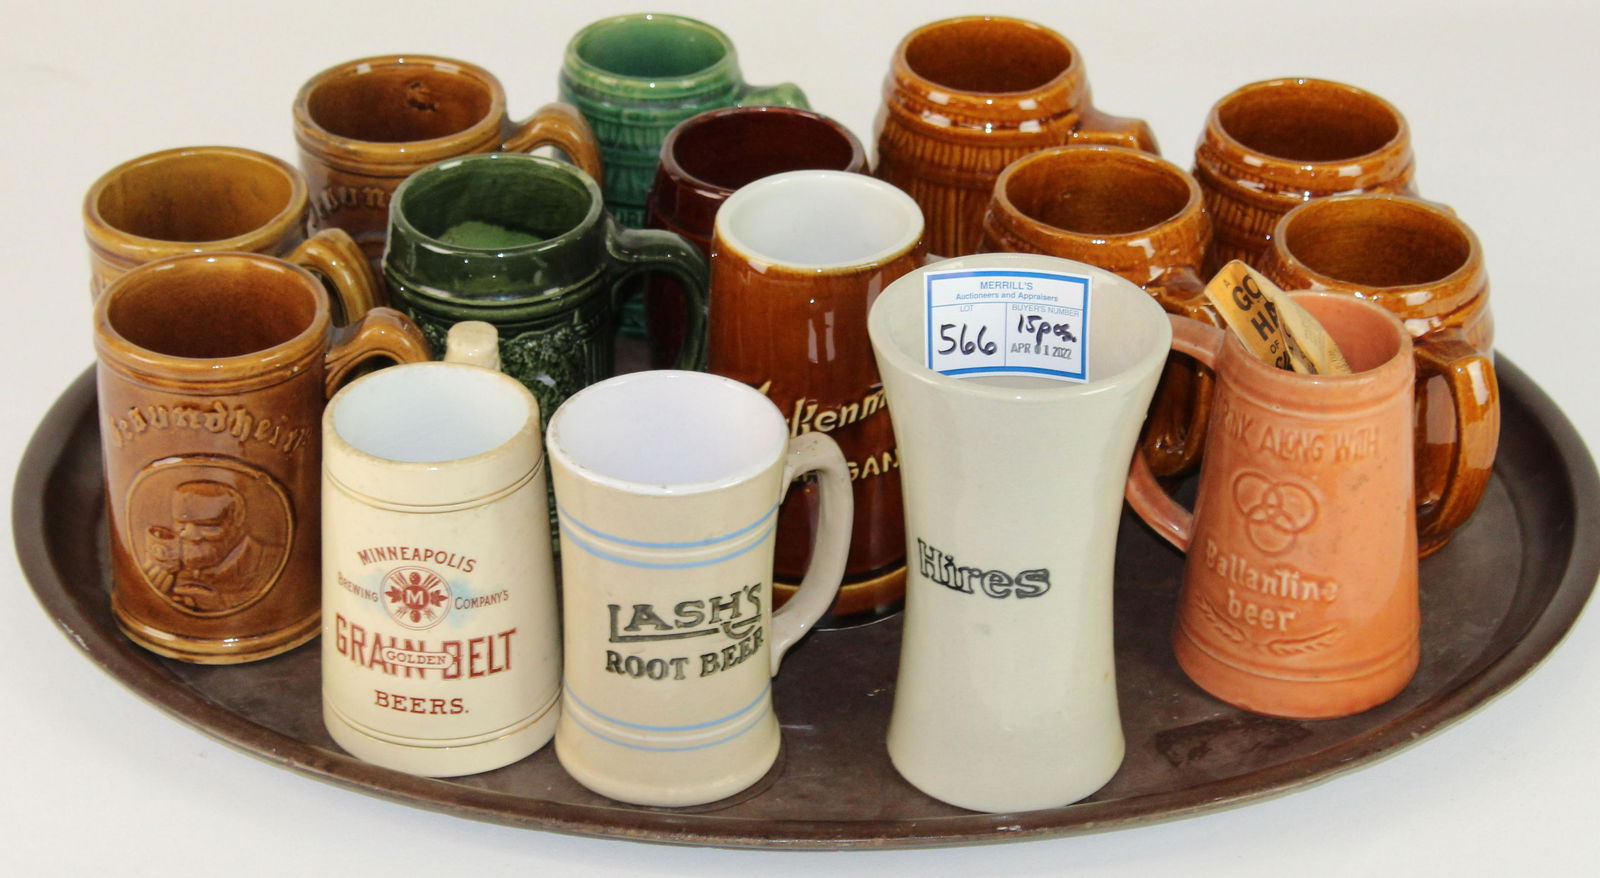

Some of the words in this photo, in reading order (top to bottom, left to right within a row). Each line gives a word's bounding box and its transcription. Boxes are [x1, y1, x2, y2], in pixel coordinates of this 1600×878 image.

[956, 292, 999, 301] Auctioneers
[1018, 292, 1059, 302] Appraisers
[980, 281, 1034, 290] MERRILL'S
[1012, 305, 1046, 314] BUYER'S
[1048, 307, 1080, 317] NUMBER
[938, 324, 998, 356] 566
[1011, 343, 1031, 354] APR
[1052, 347, 1073, 360] 2022
[1259, 425, 1325, 463] ALONG
[1333, 426, 1380, 463] WITH
[357, 546, 477, 574] MINNEAPOLIS
[917, 536, 1052, 600] Hires
[338, 571, 379, 603] BREWING
[608, 582, 763, 643] LASH'S
[1228, 588, 1297, 633] beer
[386, 650, 447, 666] GOLDEN
[442, 627, 518, 680] BELT
[605, 649, 690, 681] ROOT
[699, 625, 764, 678] BEER
[374, 689, 470, 715] BEERS.
